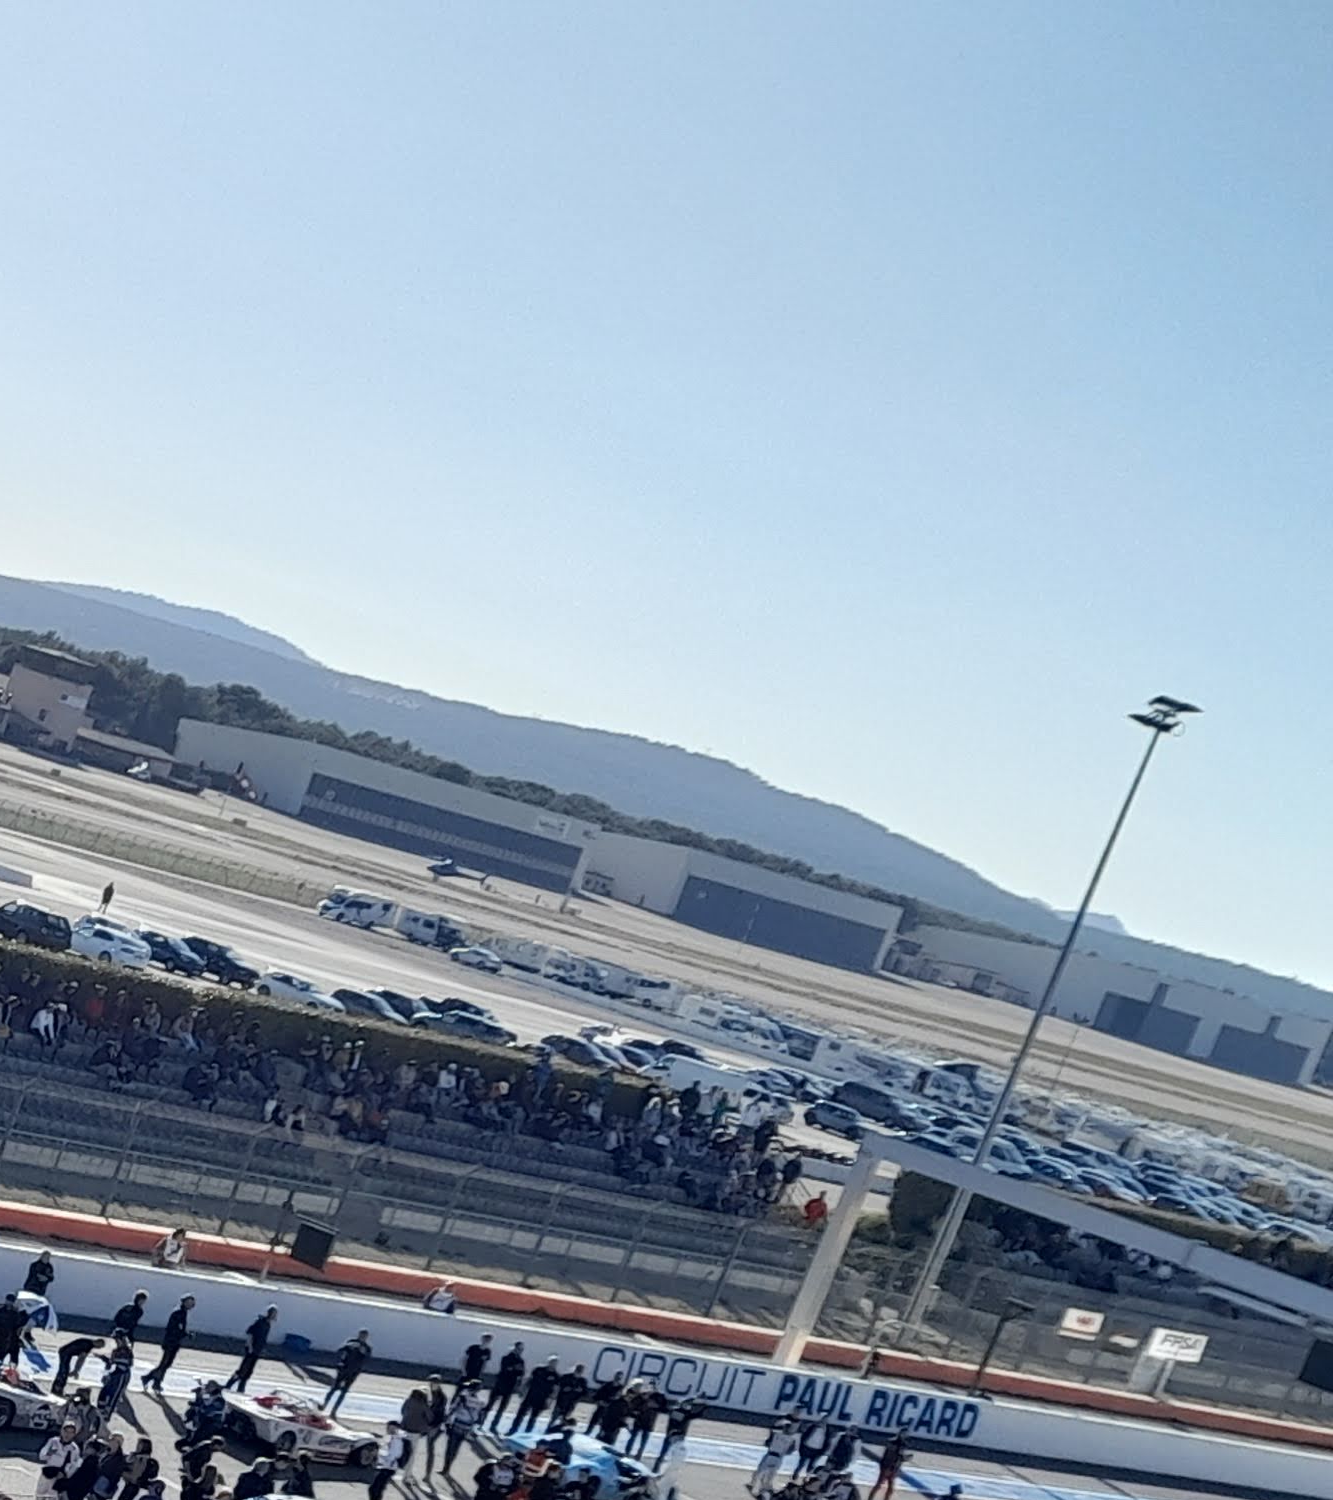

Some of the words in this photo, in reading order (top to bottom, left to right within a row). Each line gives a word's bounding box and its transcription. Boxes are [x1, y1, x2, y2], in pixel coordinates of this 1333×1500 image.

[594, 1347, 765, 1405] CIRCUIT
[774, 1375, 852, 1422] PAUL
[865, 1389, 981, 1438] RICARD
